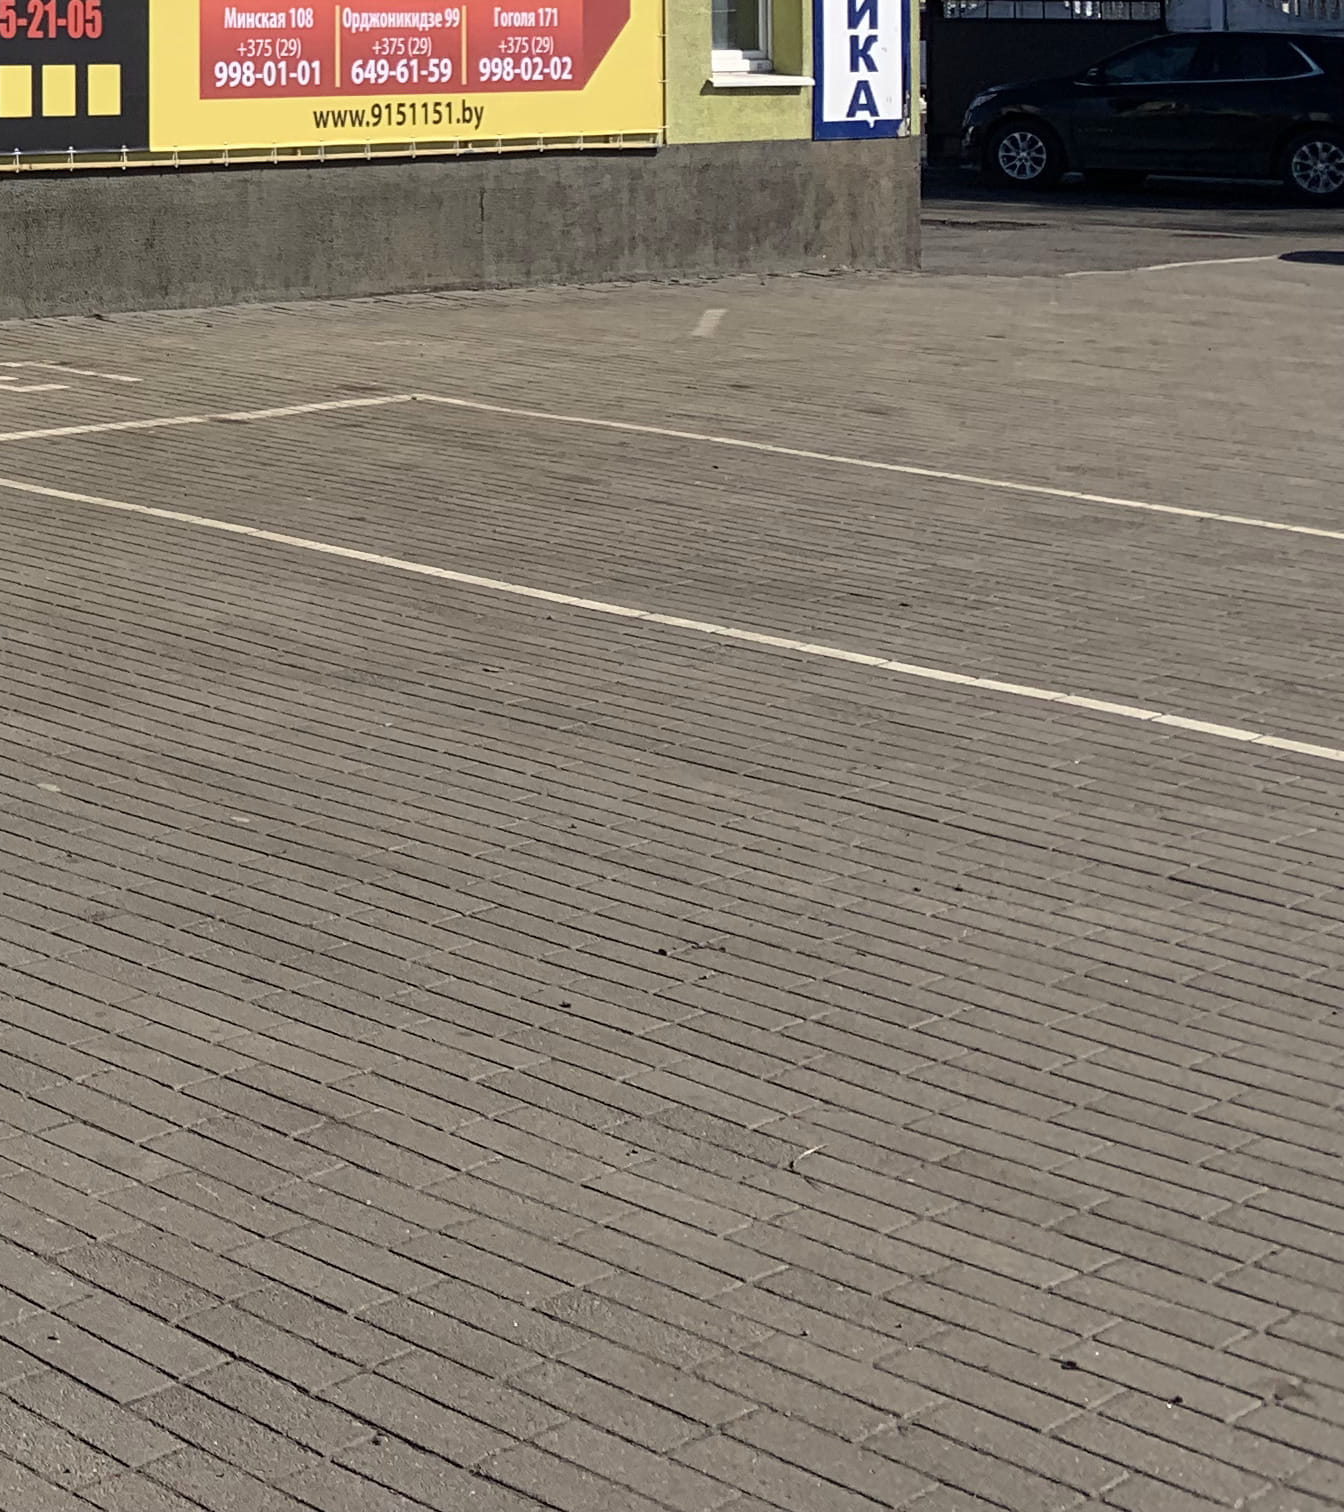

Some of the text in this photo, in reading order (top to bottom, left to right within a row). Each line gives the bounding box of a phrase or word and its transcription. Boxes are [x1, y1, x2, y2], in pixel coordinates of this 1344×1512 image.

[224, 7, 314, 29] Минская 108
[342, 7, 460, 33] Орджоникидзе 99
[493, 7, 558, 28] Гоголя 171
[237, 38, 301, 59] +375 (29)
[372, 37, 432, 57] +375 (29)
[498, 36, 554, 55] +375 (29)
[214, 60, 320, 88] 998-01-01
[351, 58, 452, 84] 649-61-59
[479, 56, 573, 82] 998-02-02
[313, 99, 484, 130] www.9151151.by
